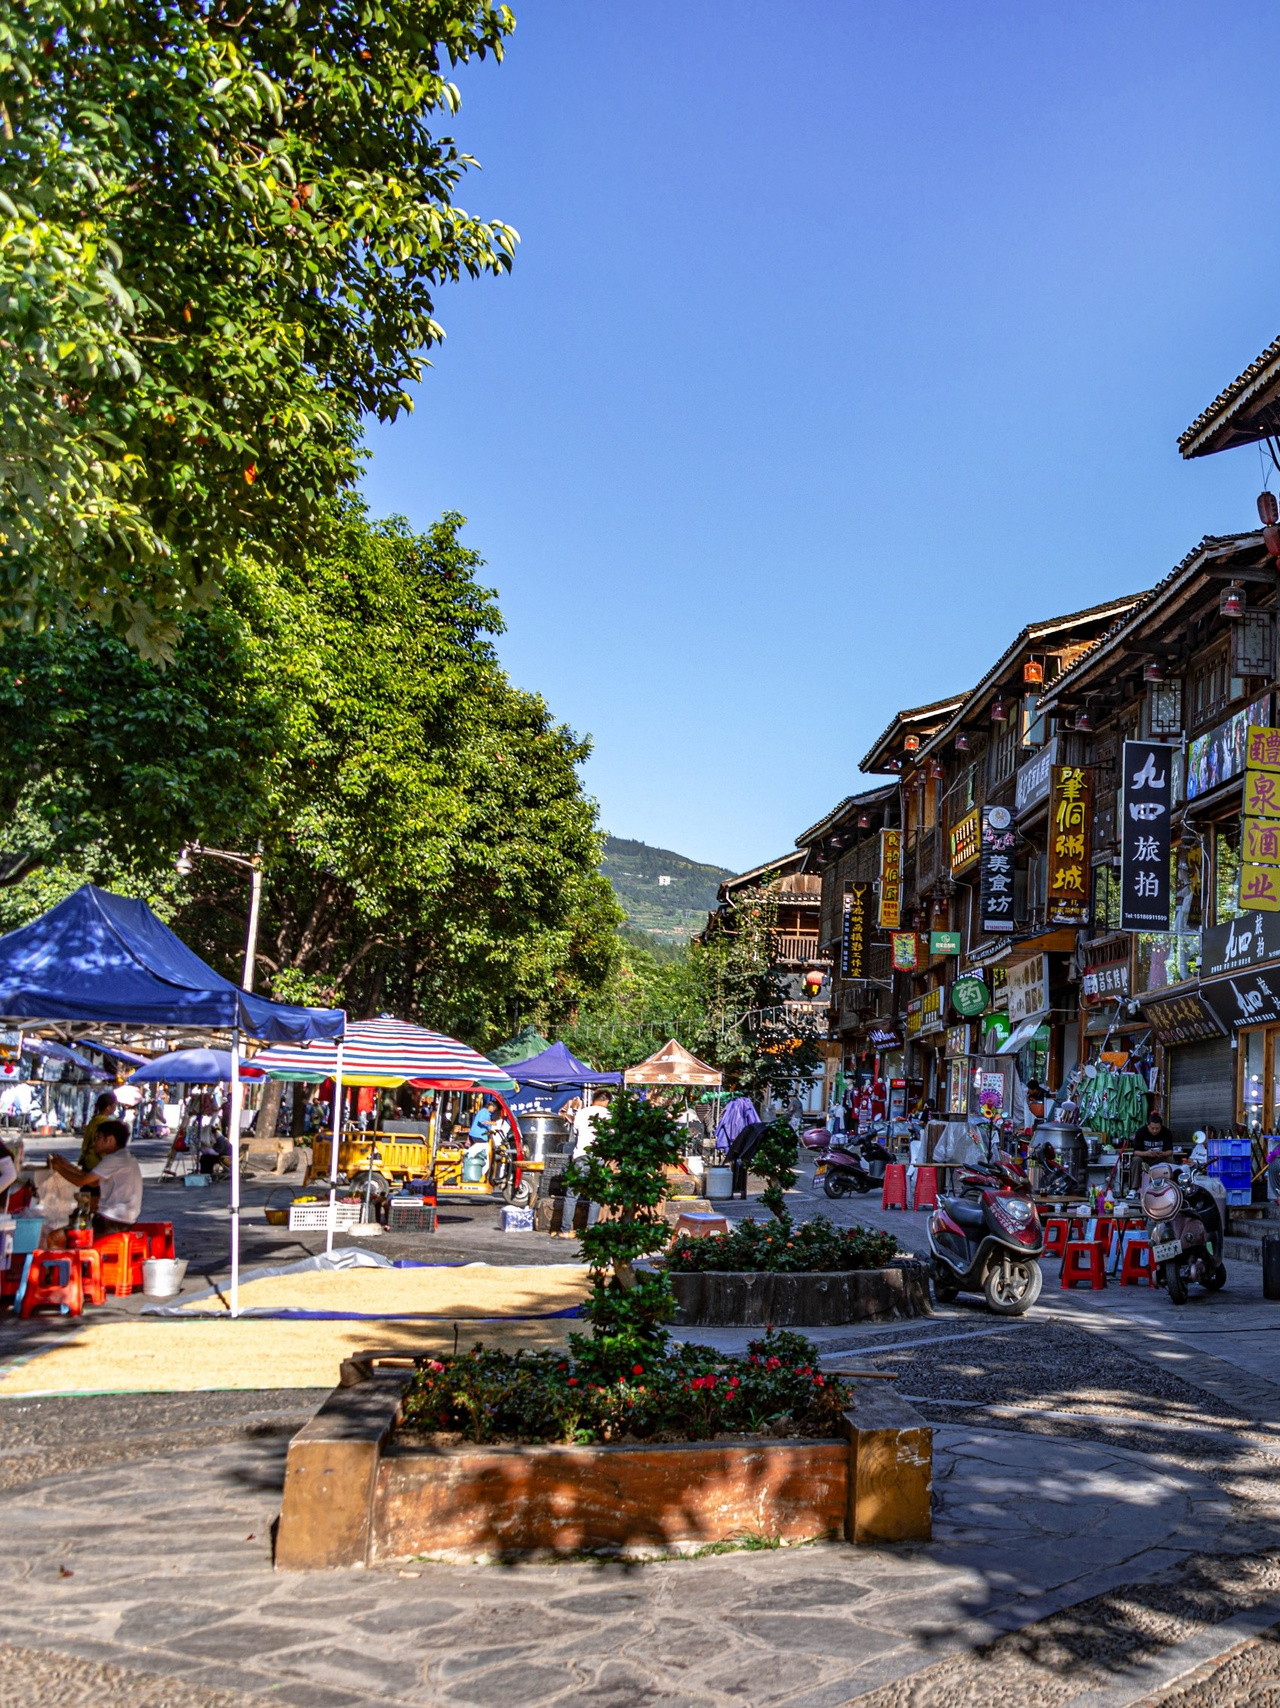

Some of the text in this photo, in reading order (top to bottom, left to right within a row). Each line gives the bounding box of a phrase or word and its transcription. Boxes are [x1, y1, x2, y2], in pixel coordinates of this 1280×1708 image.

[1130, 752, 1166, 898] 九四旅拍
[986, 854, 1014, 914] 美食坊
[957, 981, 982, 1006] 药
